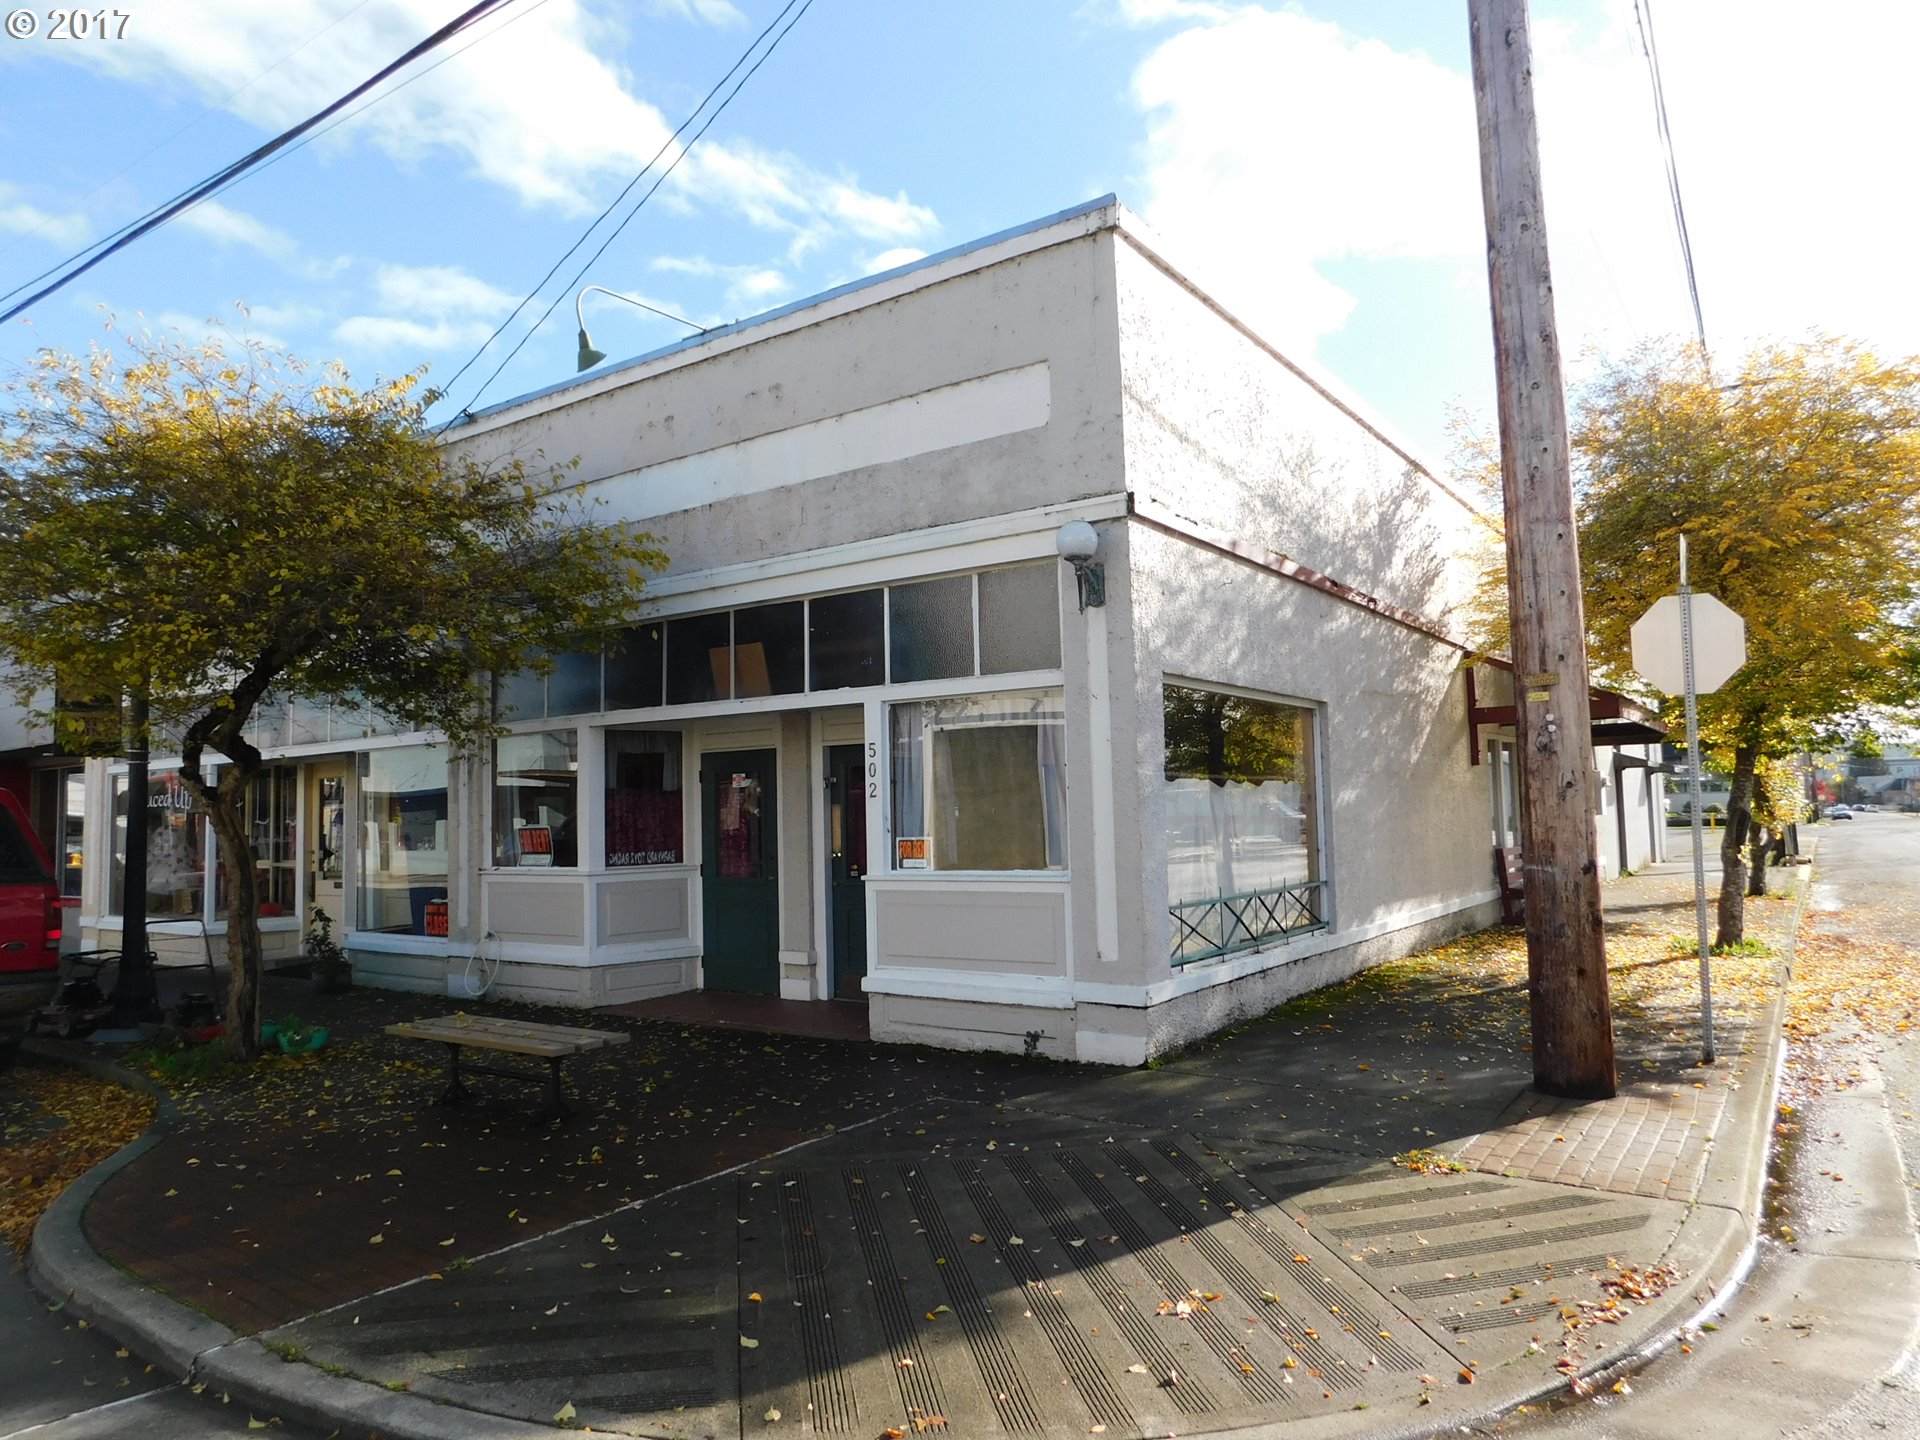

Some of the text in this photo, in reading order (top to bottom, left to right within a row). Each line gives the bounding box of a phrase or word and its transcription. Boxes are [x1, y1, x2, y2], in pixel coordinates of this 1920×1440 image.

[868, 742, 877, 798] 502
[174, 785, 192, 818] Up
[899, 841, 912, 859] FOR
